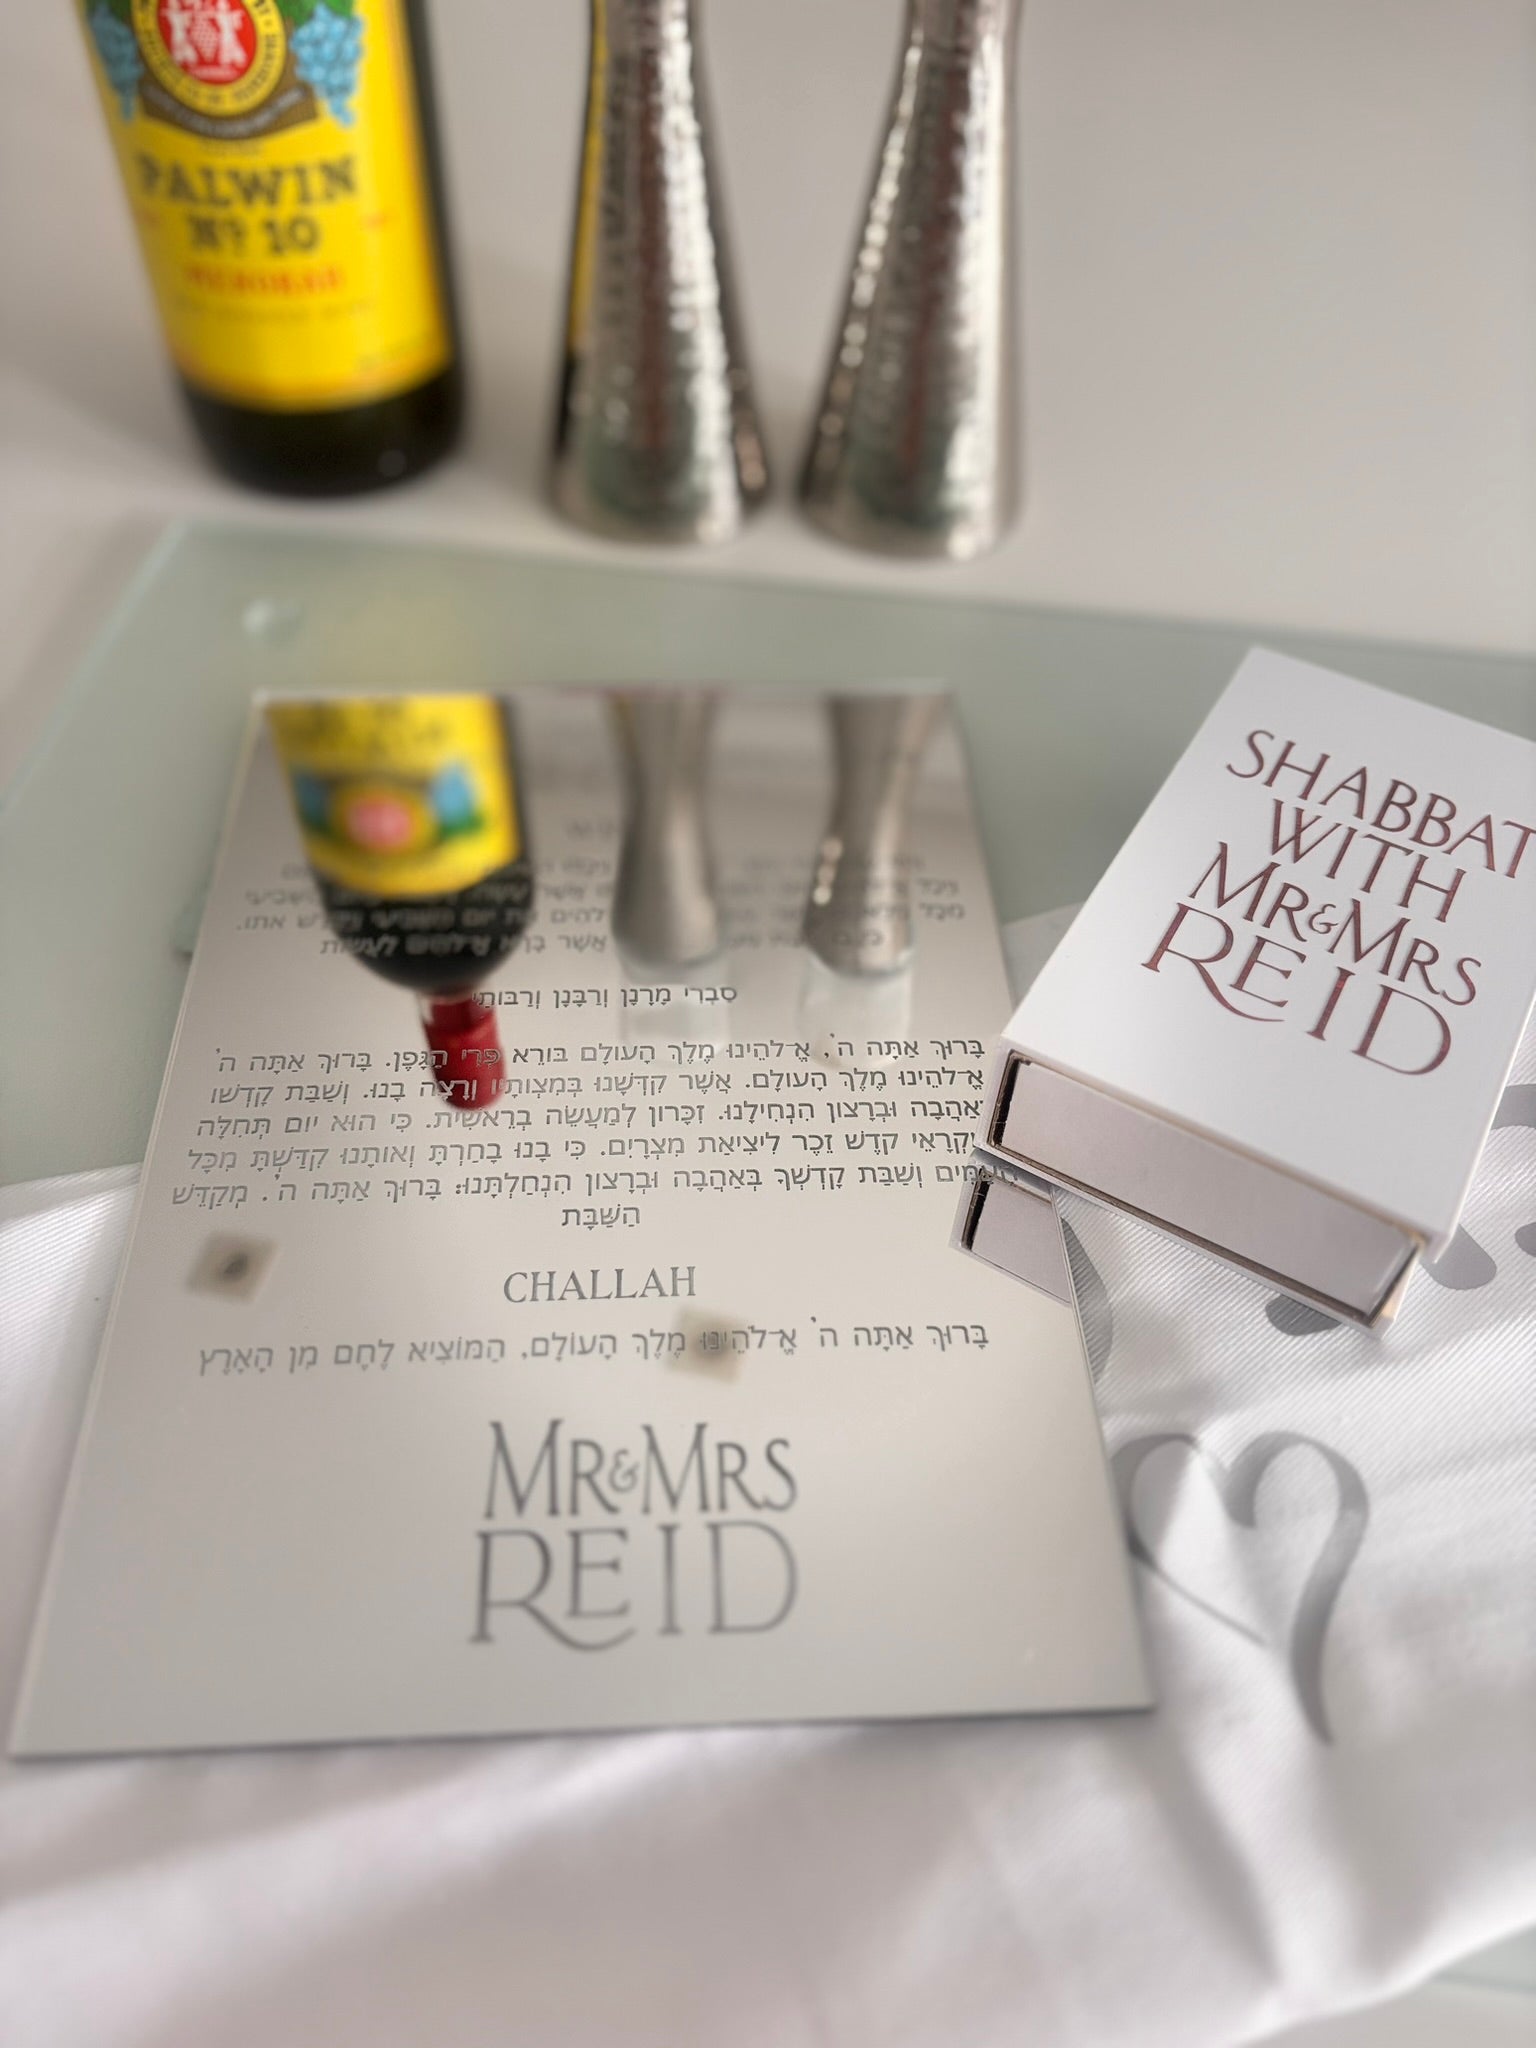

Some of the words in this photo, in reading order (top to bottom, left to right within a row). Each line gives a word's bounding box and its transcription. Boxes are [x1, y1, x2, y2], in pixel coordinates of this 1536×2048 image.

[136, 153, 357, 209] PALWIN
[1225, 729, 1536, 880] SHABBAT
[1271, 797, 1467, 924] WITH
[1141, 902, 1453, 1077] REID
[911, 1099, 984, 1122] אַהֲבָה
[504, 1266, 696, 1303] CHALLAH
[469, 1520, 798, 1653] REID
